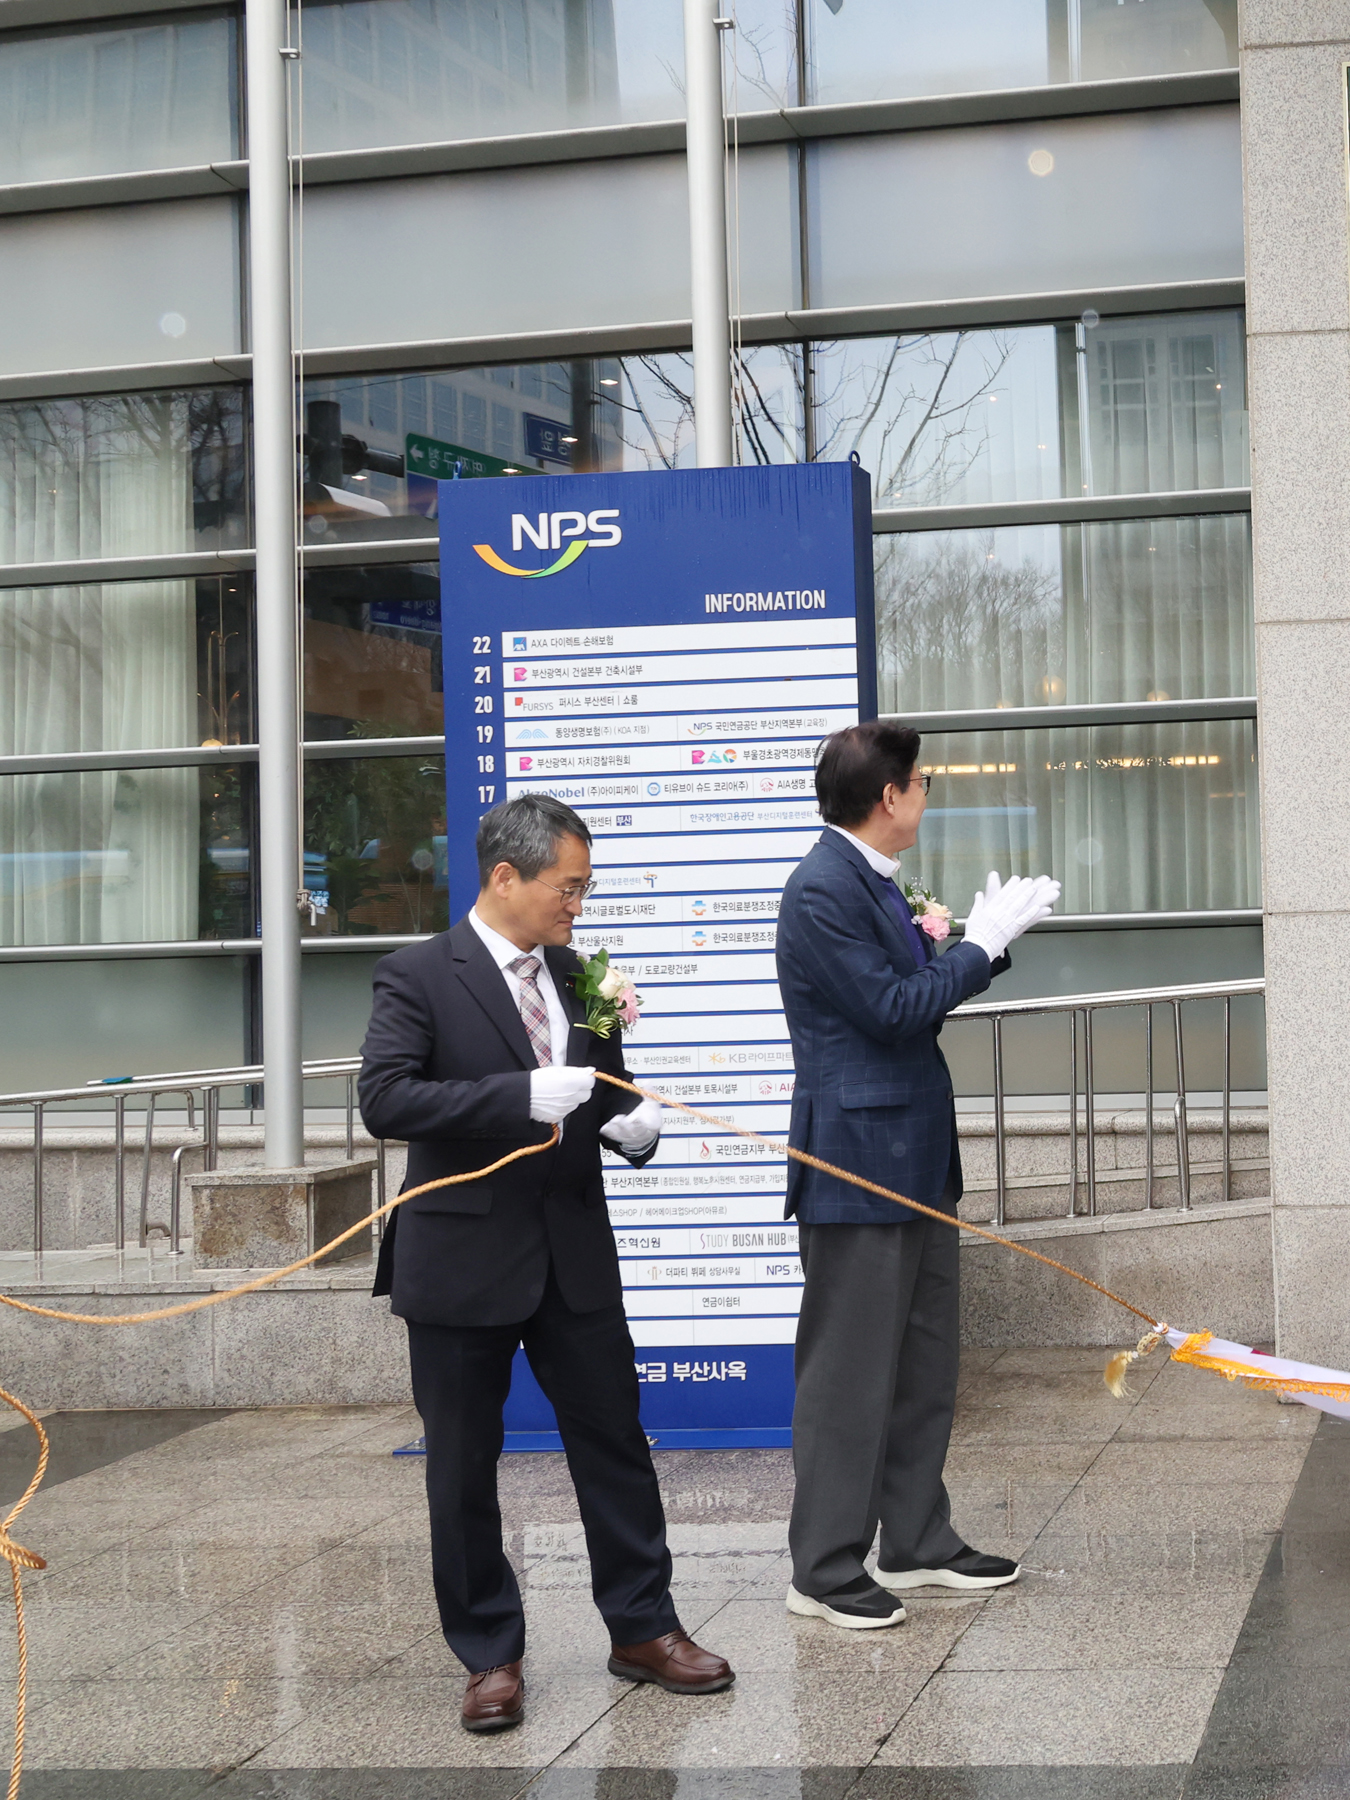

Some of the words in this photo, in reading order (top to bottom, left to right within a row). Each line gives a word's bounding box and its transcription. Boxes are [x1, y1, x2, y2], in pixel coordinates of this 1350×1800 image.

[511, 509, 623, 551] NPS
[704, 589, 826, 614] INFORMATION
[472, 635, 492, 654] 22
[531, 638, 549, 648] AXA
[550, 636, 581, 648] 다이렉트
[583, 634, 614, 647] 손해보험
[474, 665, 491, 684] 21
[531, 667, 570, 679] 부산광역시
[572, 666, 603, 678] 건설본부
[605, 664, 643, 677] 건축시설부
[474, 695, 493, 714] 20
[522, 702, 554, 711] FURSYS
[558, 695, 582, 707] 퍼시스
[584, 694, 615, 707] 부산센터
[623, 693, 639, 706] 쇼룸
[693, 722, 713, 731] NPS
[715, 720, 758, 731] 국민연금공단
[476, 725, 494, 744] 19
[477, 755, 495, 773] 18
[537, 757, 575, 769] 부산광역시
[577, 754, 631, 768] 자치경찰위원회
[664, 782, 694, 793] 티유브이
[777, 777, 806, 790] AIA생명
[478, 785, 496, 803] 17
[616, 815, 632, 826] 부산
[594, 875, 642, 887] 디지털훈련센터
[580, 904, 656, 918] 역시글로벌도시재단
[578, 935, 624, 947] 부산울산지원
[713, 931, 778, 943] 한국의료분쟁조정
[645, 963, 699, 976] 도로교량건설부
[674, 1084, 702, 1096] 건설본부
[715, 1144, 766, 1156] 국민연금지부
[611, 1176, 659, 1188] 부산지역본부
[700, 1233, 730, 1250] STUDY
[732, 1233, 764, 1247] BUSAN
[767, 1232, 787, 1246] HUB
[666, 1266, 689, 1278] 더파티
[766, 1265, 790, 1276] NPS
[672, 1360, 747, 1382] 부산사옥
